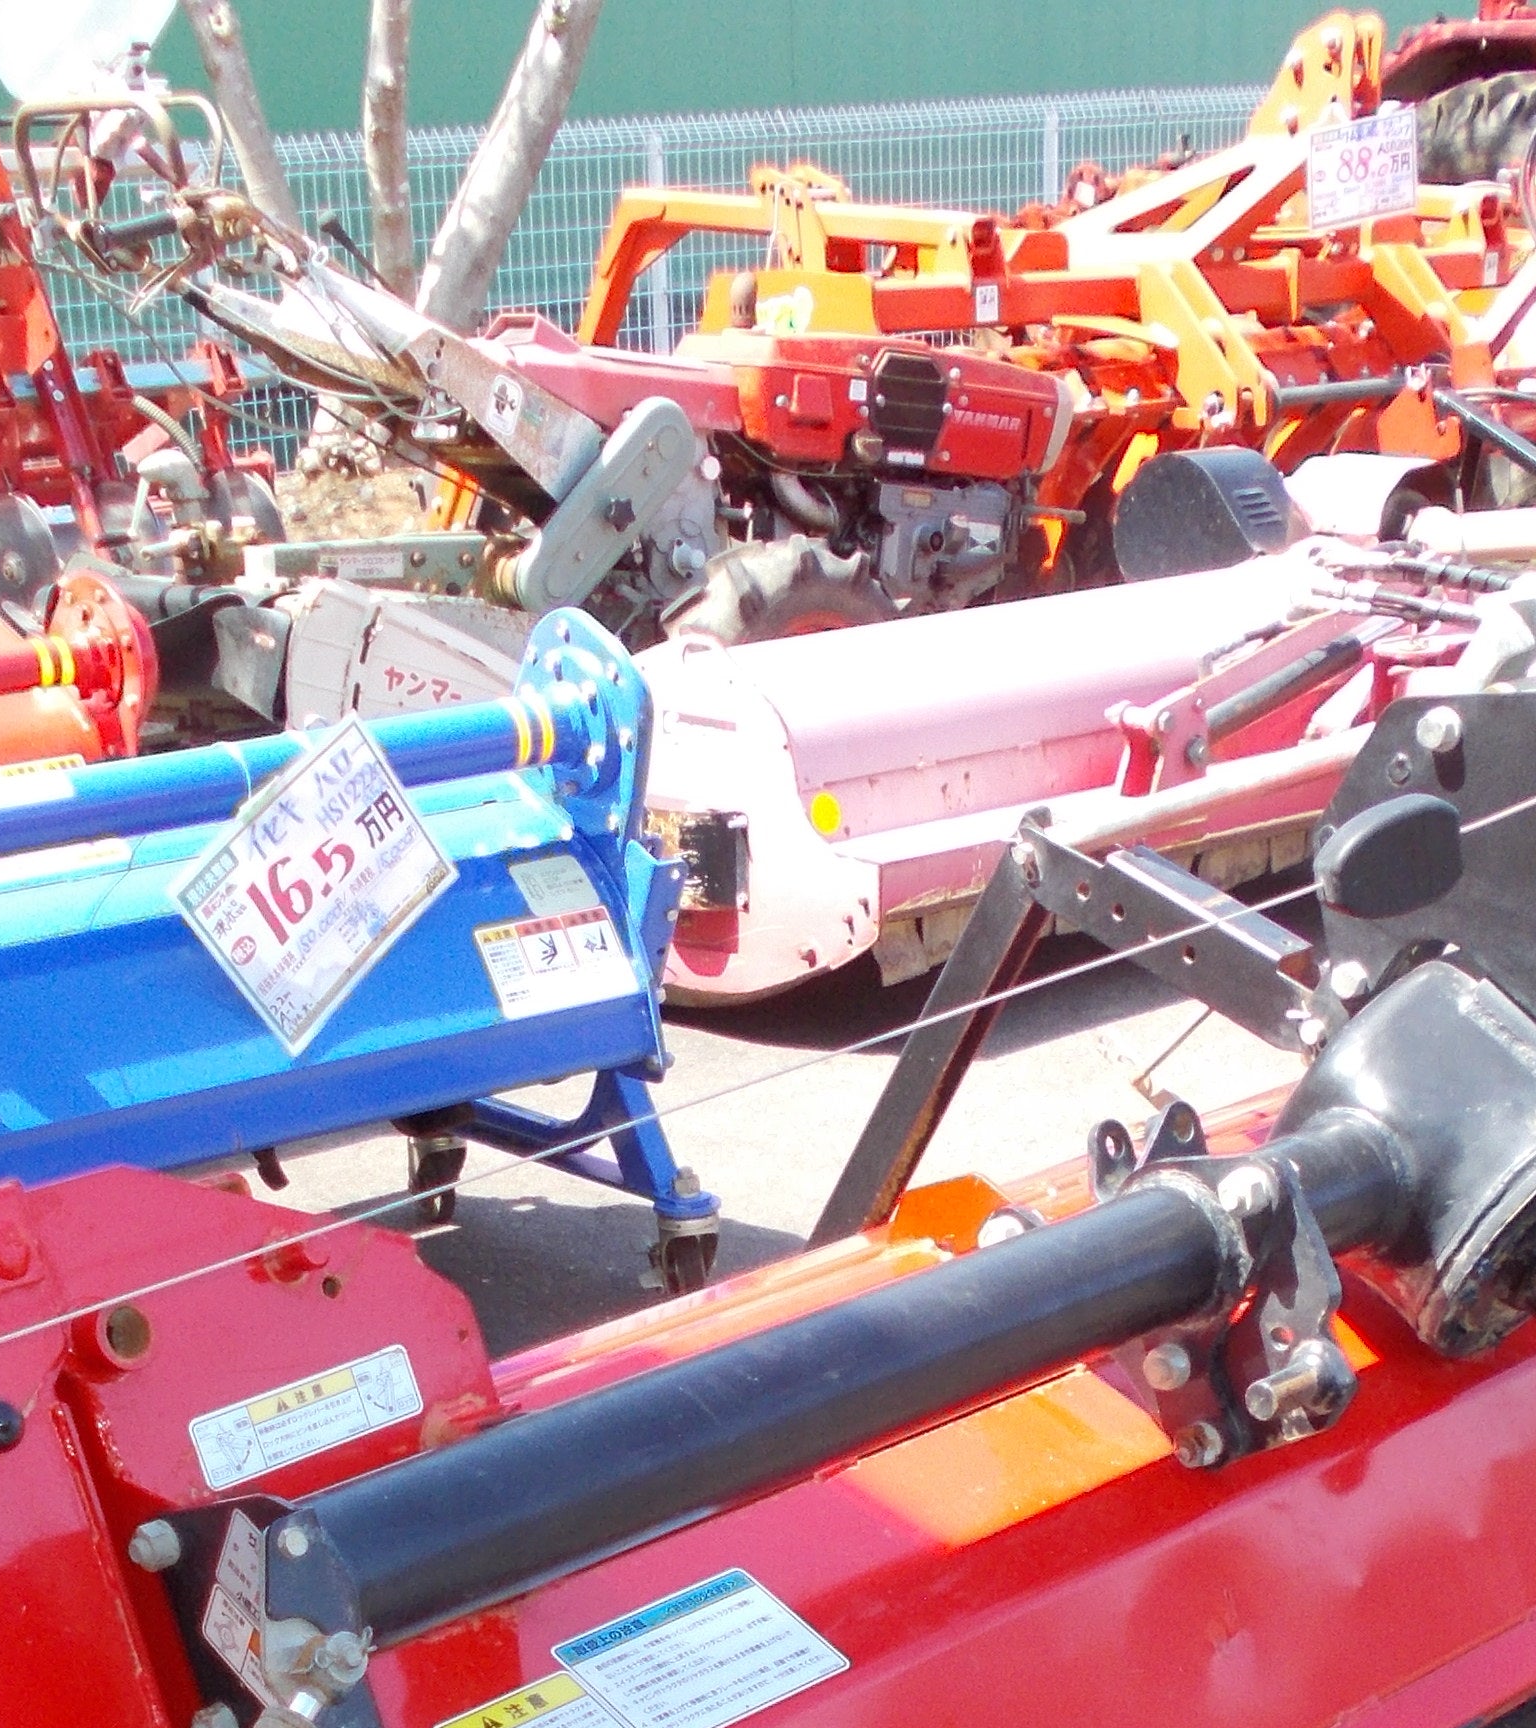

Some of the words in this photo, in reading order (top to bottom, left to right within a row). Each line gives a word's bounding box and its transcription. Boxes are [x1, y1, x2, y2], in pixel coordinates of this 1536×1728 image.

[1391, 152, 1410, 173] 万円
[954, 409, 1021, 431] YANMAR
[384, 666, 462, 704] ヤンマー
[246, 837, 355, 947] 16.5
[354, 790, 404, 850] 万円
[292, 1381, 326, 1405] 注意
[502, 1691, 550, 1720] 注意
